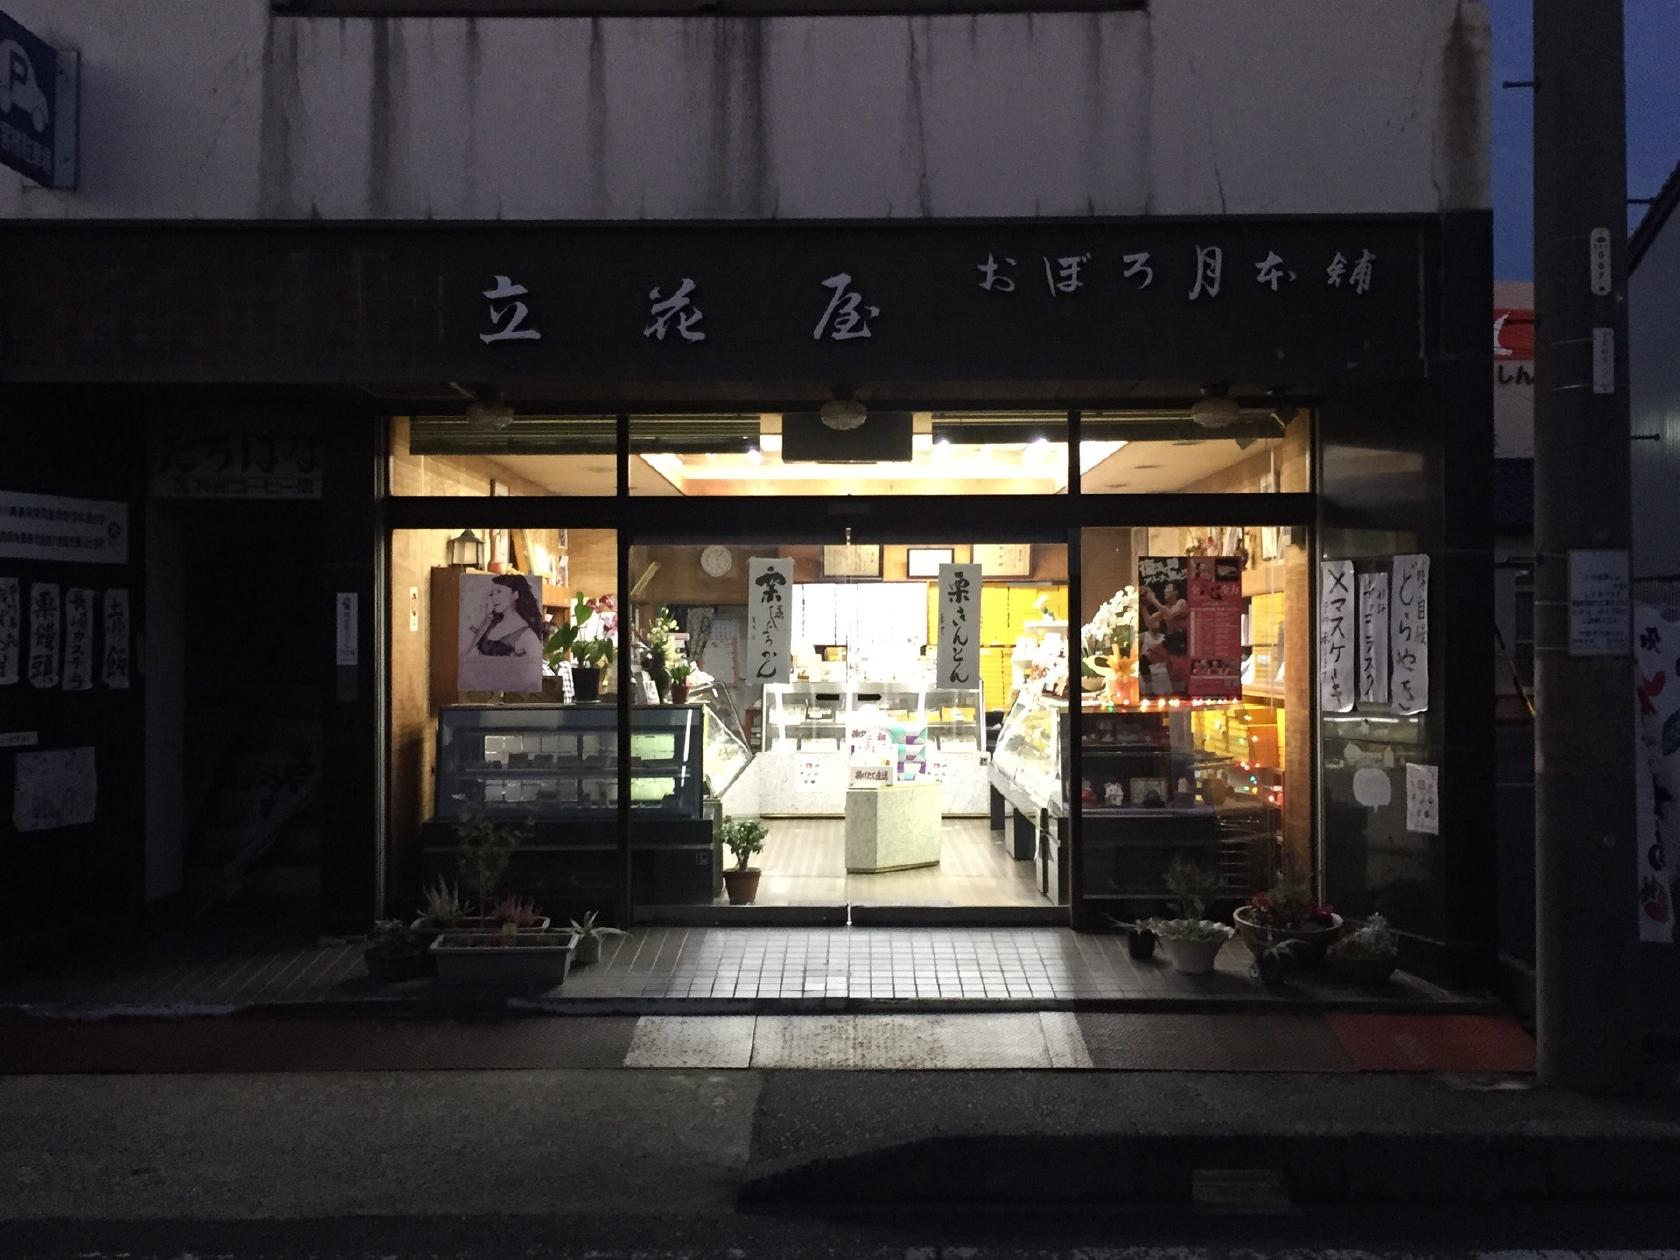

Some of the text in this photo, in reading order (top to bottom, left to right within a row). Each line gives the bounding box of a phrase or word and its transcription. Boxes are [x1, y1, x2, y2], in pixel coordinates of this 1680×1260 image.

[480, 272, 881, 346] 立花屋
[976, 244, 1377, 301] おぼろ月本舗
[946, 571, 970, 683] 栗きんとん
[1398, 561, 1419, 711] どらやき
